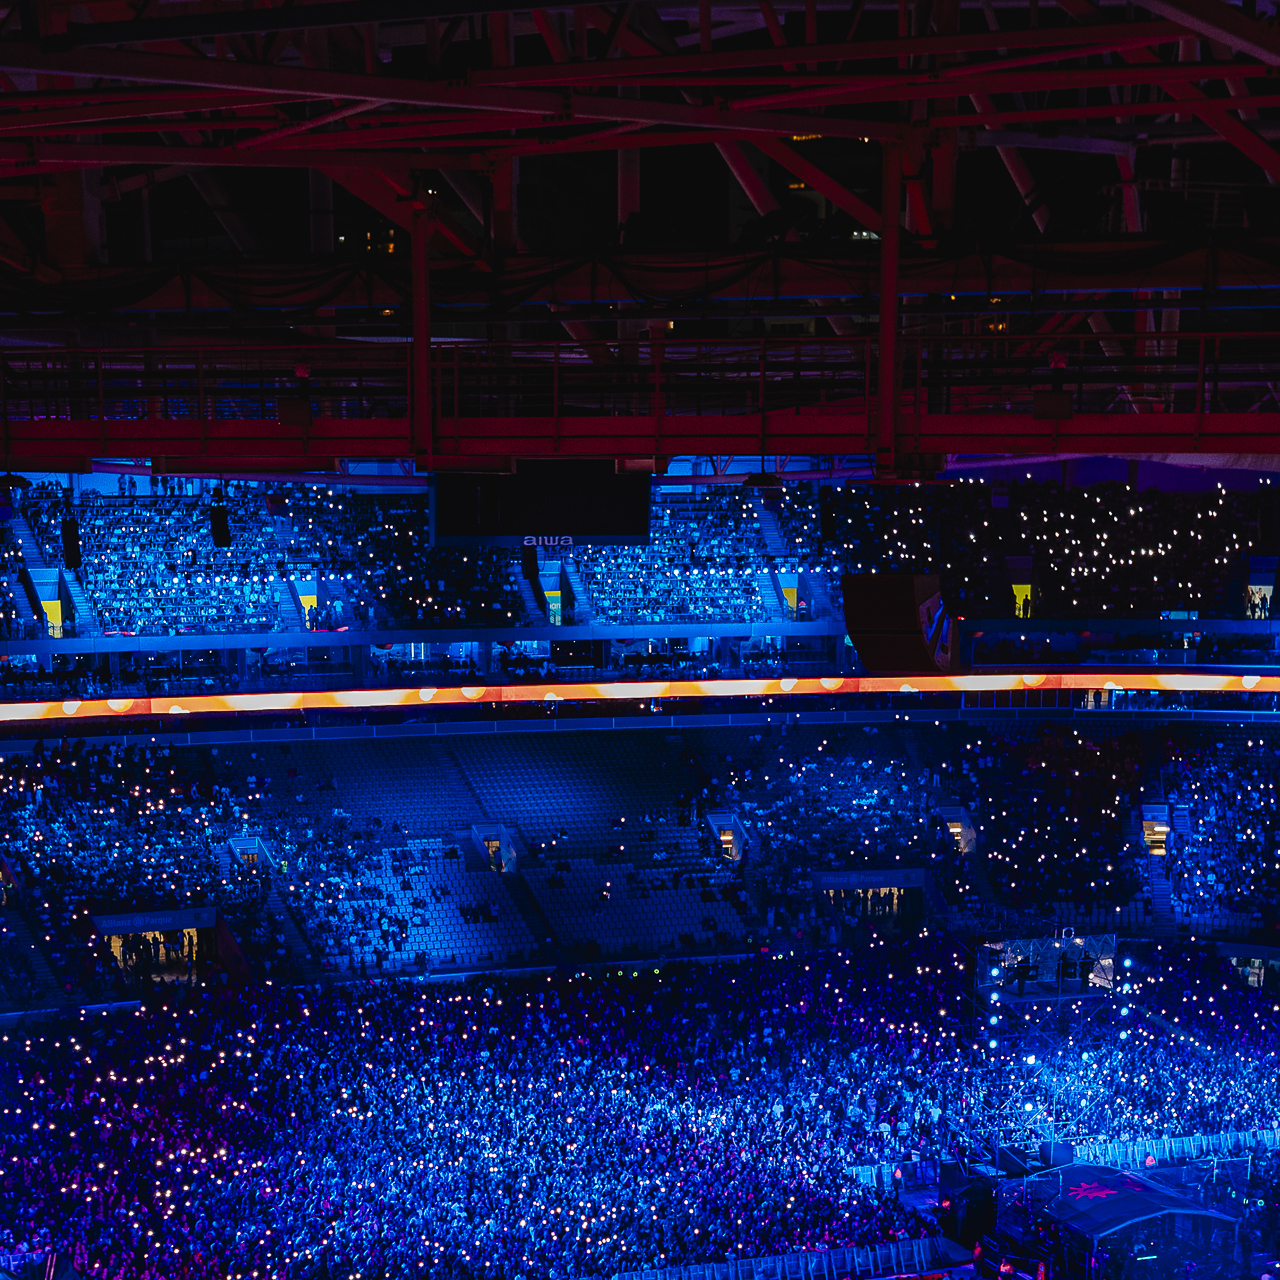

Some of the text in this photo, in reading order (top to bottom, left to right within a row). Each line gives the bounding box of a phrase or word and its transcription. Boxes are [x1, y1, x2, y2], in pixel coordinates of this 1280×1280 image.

[523, 536, 573, 546] aiwa
[821, 876, 849, 884] Allianz
[860, 874, 885, 883] Parque
[101, 918, 132, 928] Allianz
[145, 916, 173, 925] Parque
